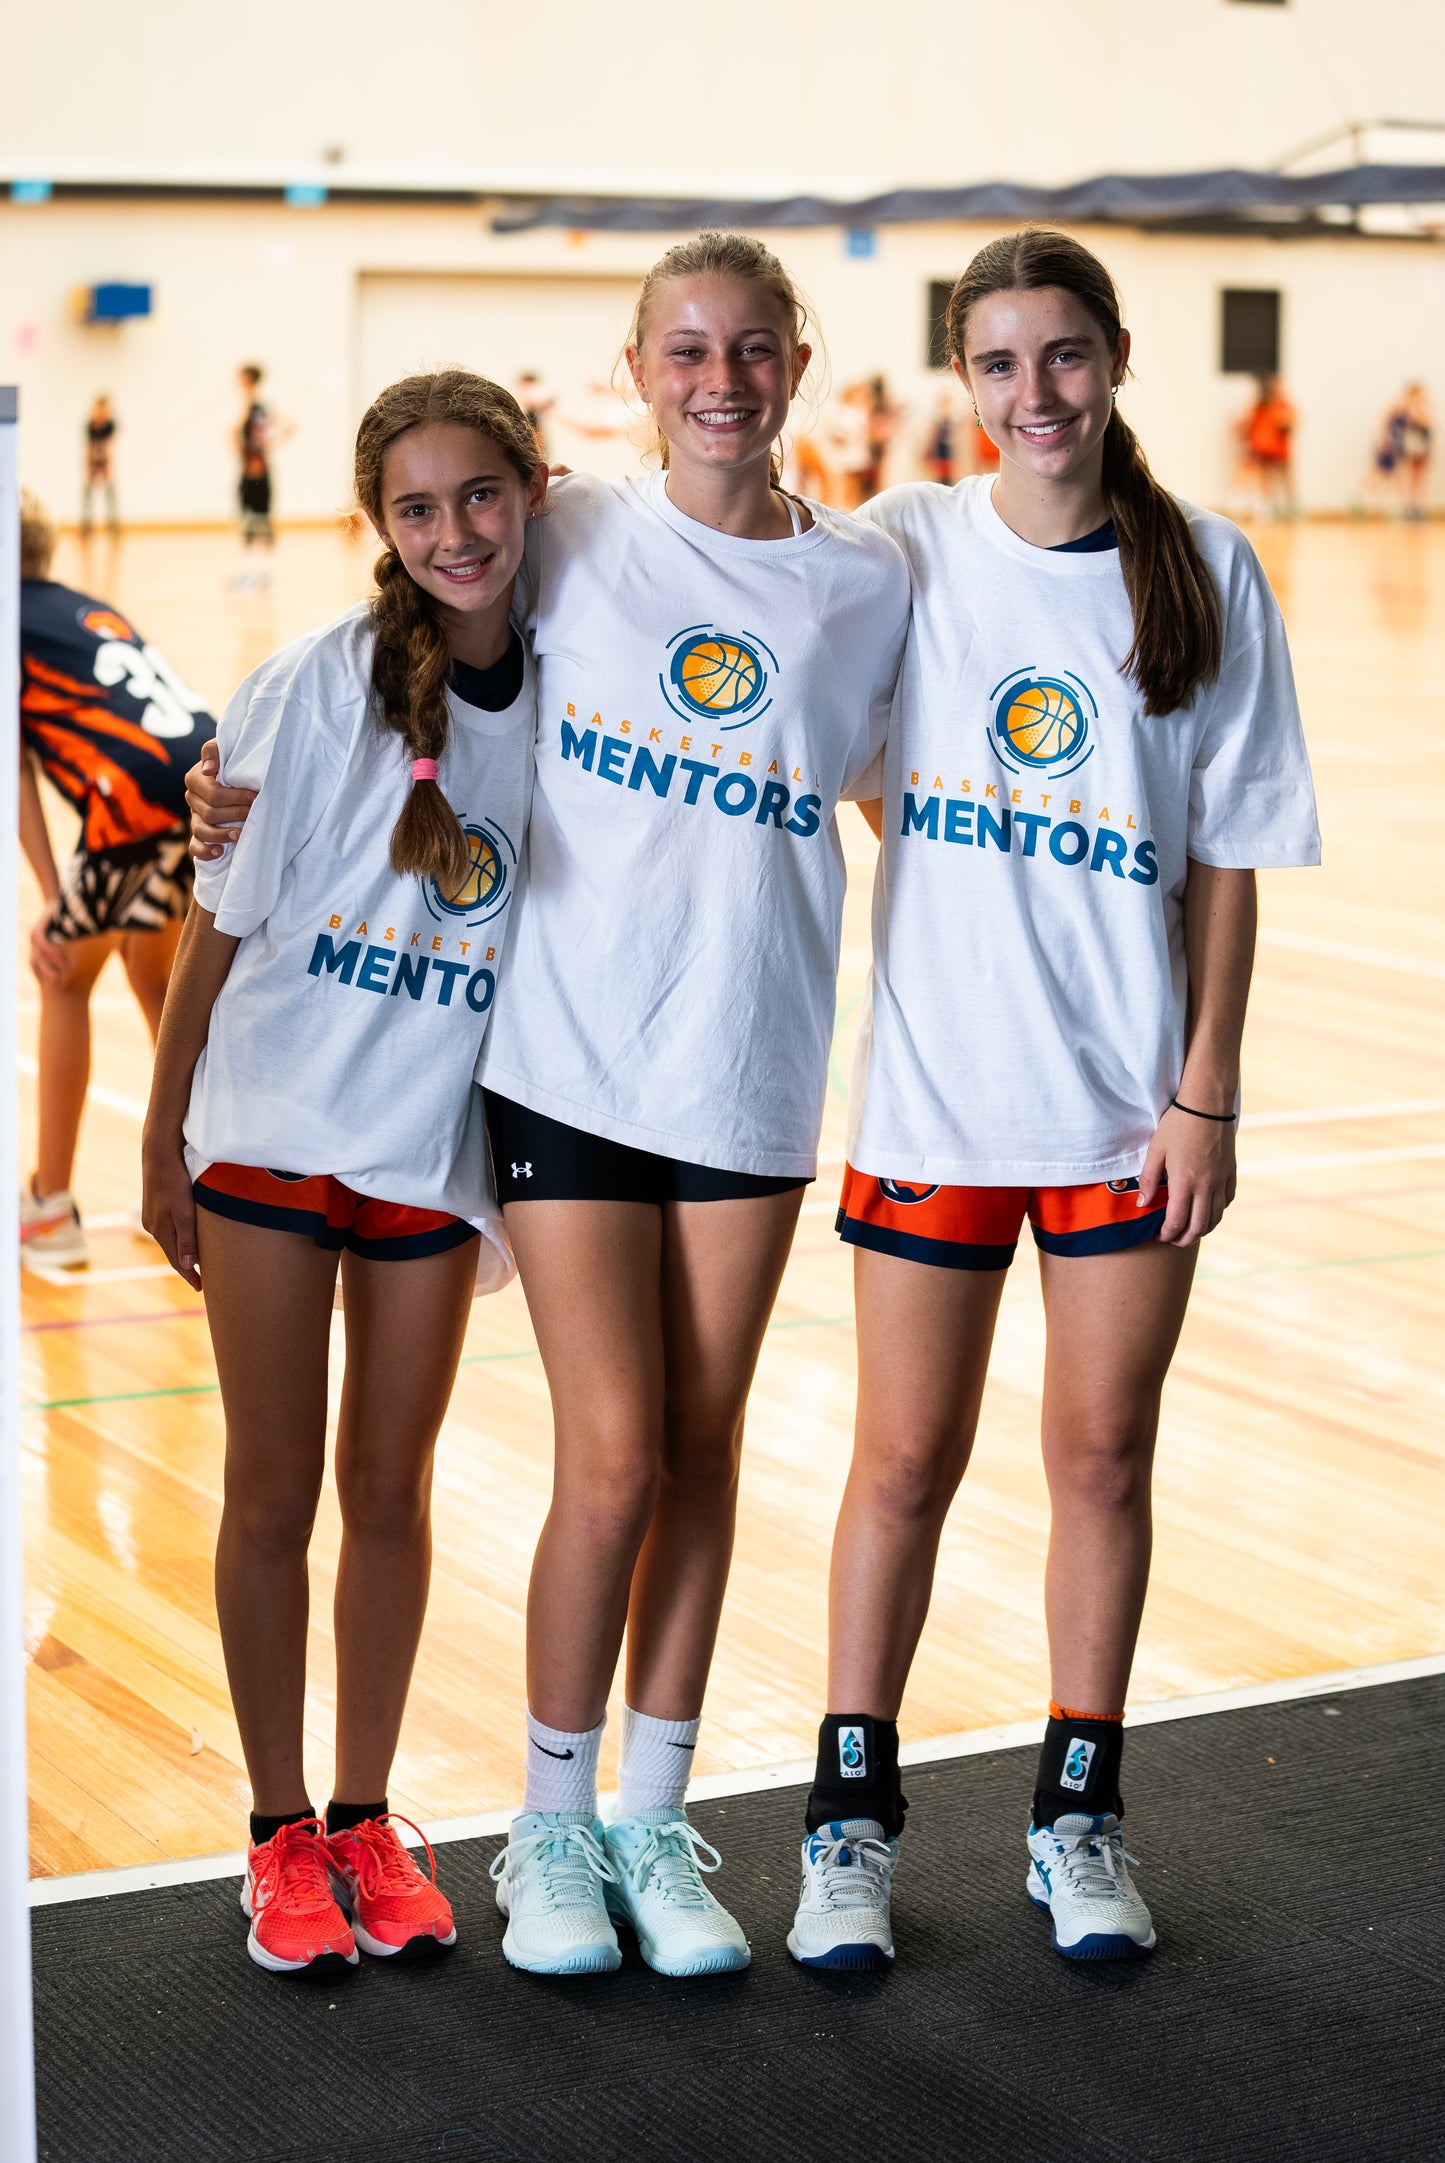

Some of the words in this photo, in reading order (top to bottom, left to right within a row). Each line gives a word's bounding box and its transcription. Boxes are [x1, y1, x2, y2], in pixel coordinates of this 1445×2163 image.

[560, 719, 822, 837] MENTORS
[910, 771, 1153, 834] BASKETBAL
[900, 792, 1159, 886] MENTORS
[307, 933, 496, 1013] MENTO
[328, 913, 497, 962] BASKETB
